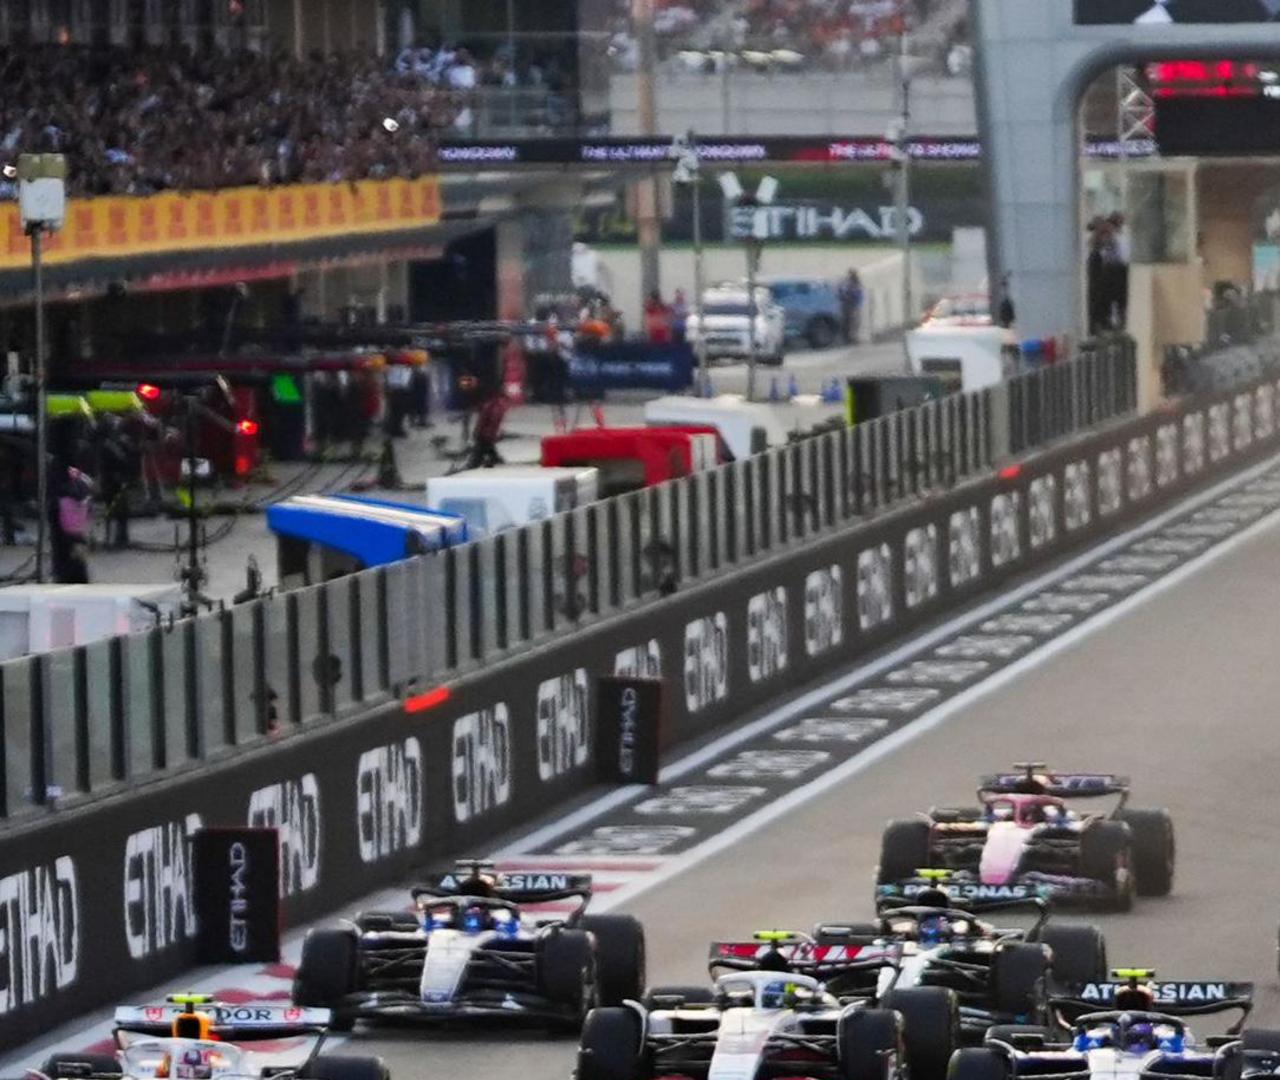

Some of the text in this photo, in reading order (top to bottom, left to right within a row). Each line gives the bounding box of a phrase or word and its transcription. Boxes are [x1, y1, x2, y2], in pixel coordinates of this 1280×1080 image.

[452, 702, 511, 822] ETIHAD
[537, 667, 589, 782] ETIHAD
[357, 737, 424, 863] ETIHAD
[229, 841, 248, 953] ETIHAD
